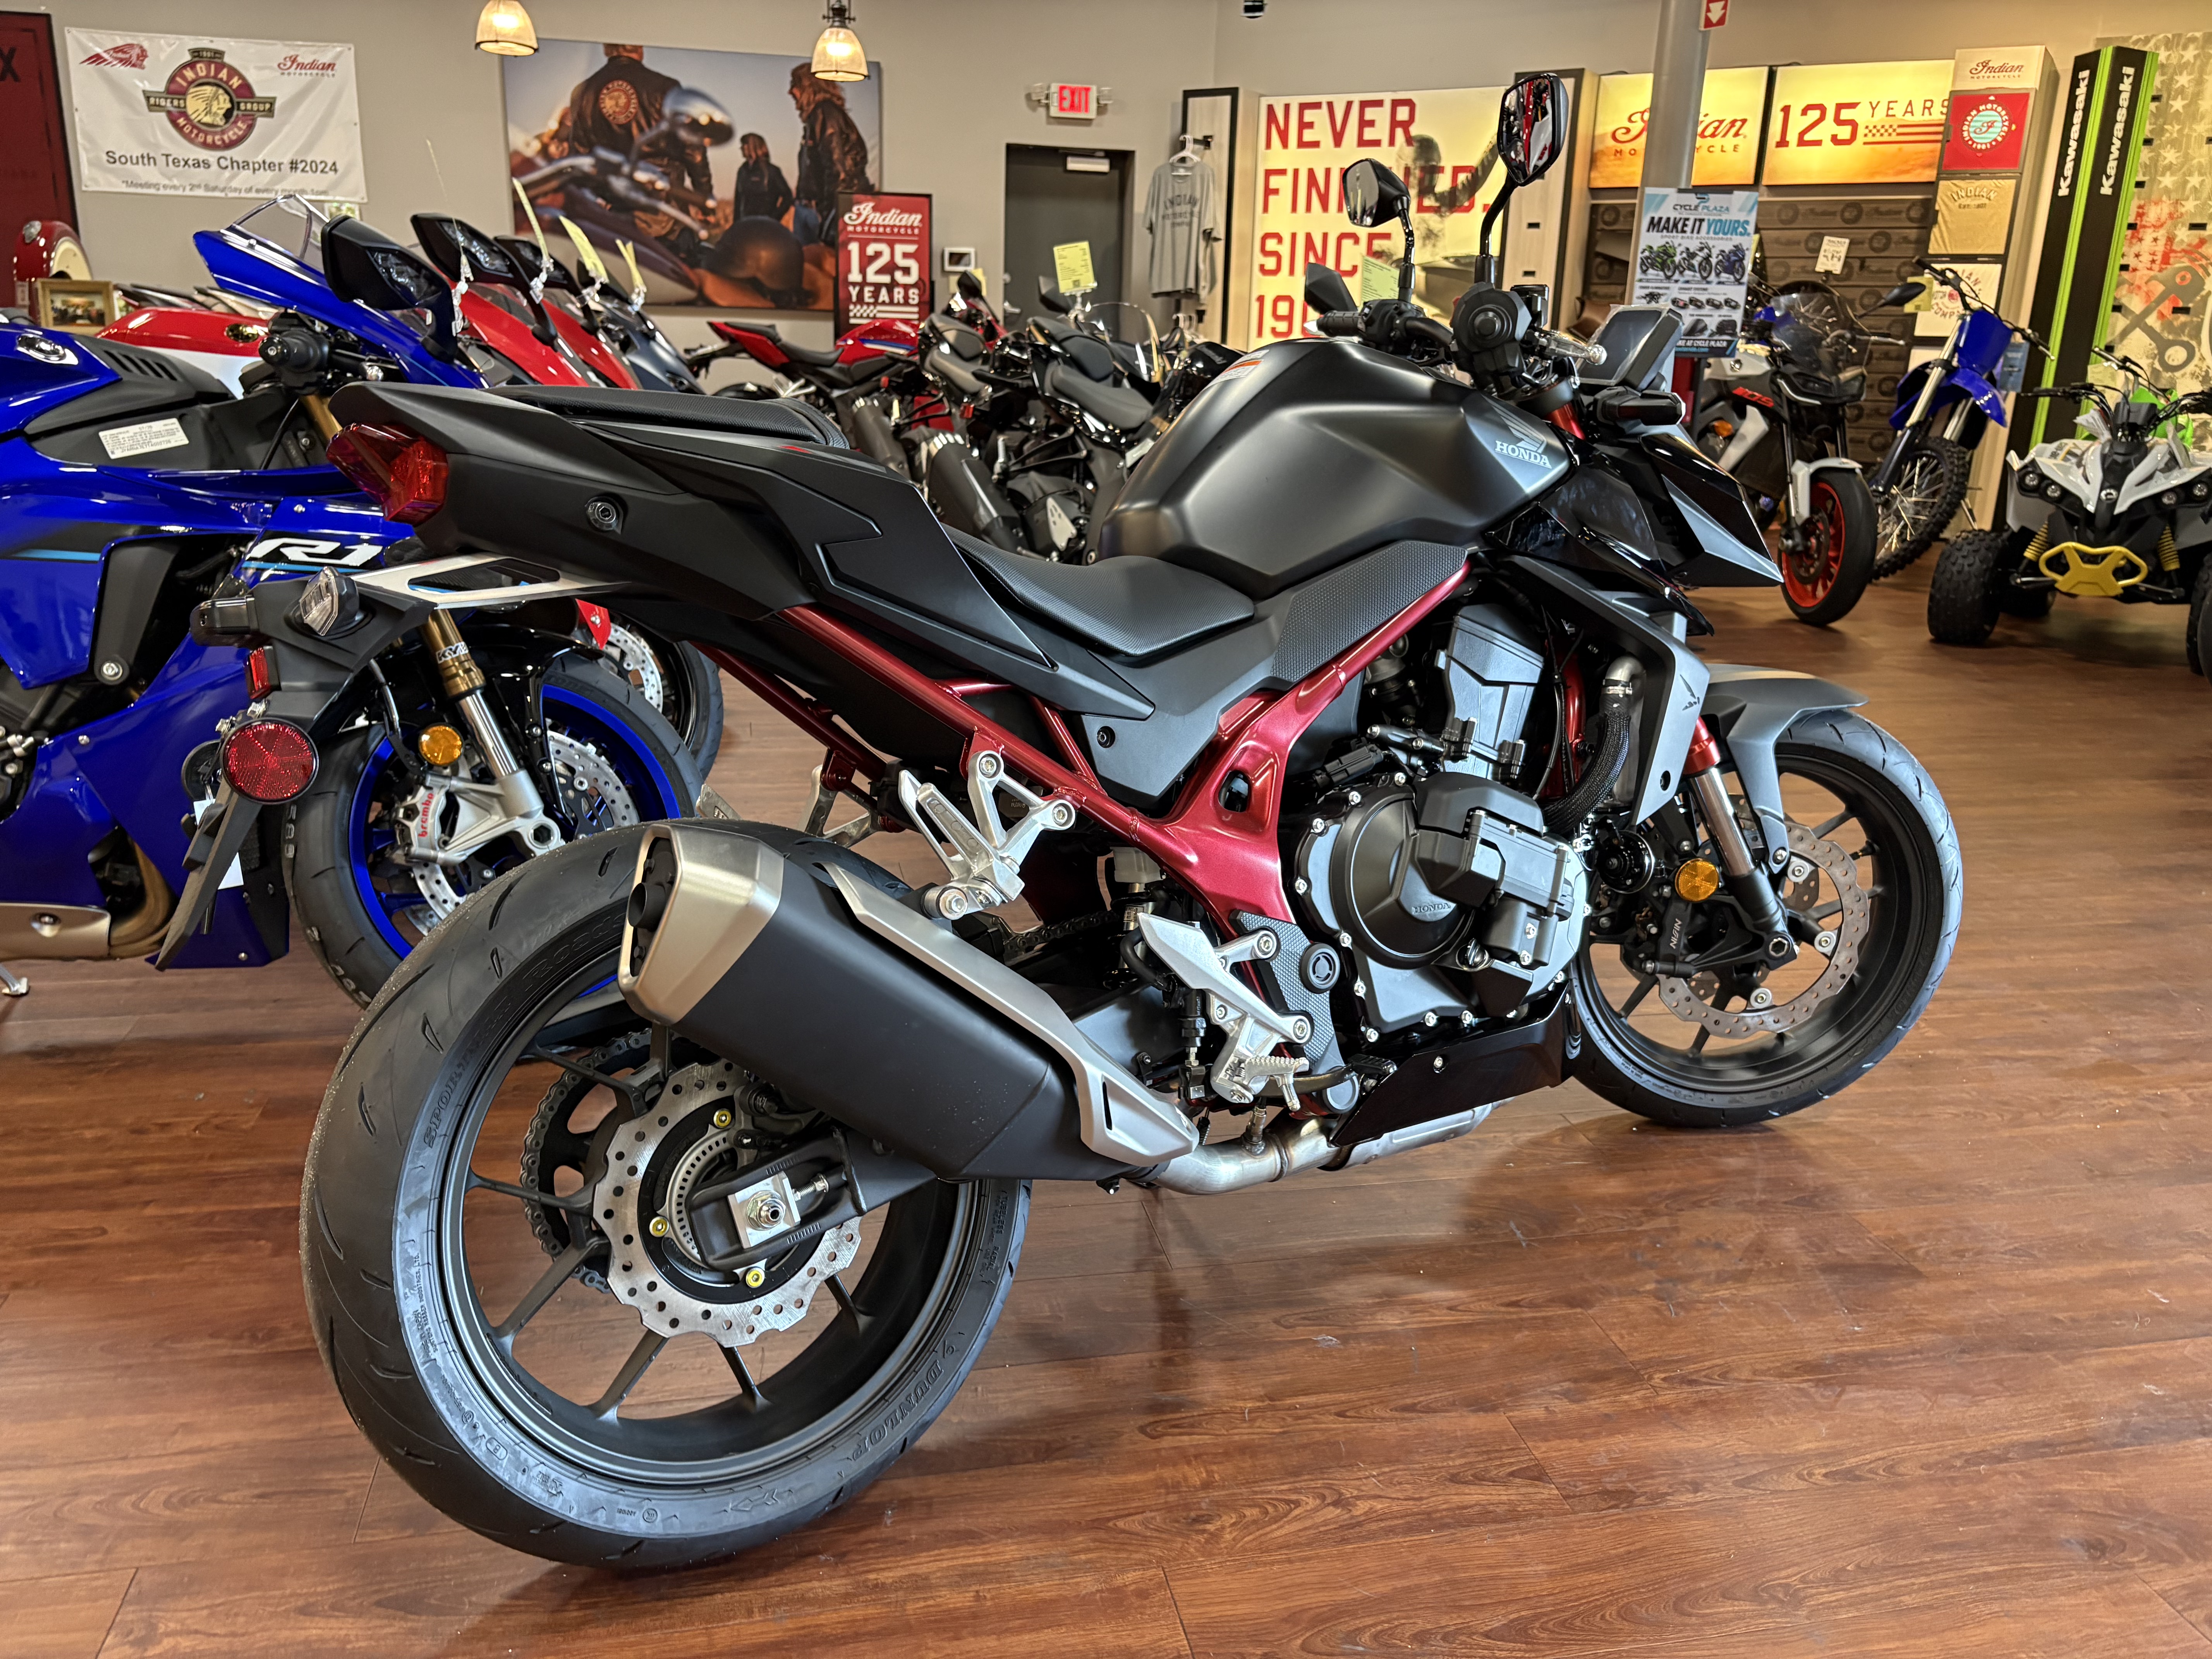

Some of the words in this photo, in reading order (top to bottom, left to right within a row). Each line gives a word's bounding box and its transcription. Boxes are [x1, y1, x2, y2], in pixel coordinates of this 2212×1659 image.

[176, 63, 243, 89] INDIAN
[277, 54, 336, 72] Indian
[1969, 60, 2024, 75] Indian
[149, 97, 185, 107] RIDERS
[240, 102, 271, 111] GROUP
[1058, 85, 1091, 114] EXIT
[177, 117, 247, 145] MOTORCYCLE
[1266, 99, 1416, 150] NEVER
[1775, 101, 1861, 148] 125
[1869, 99, 1949, 118] YEARS
[1962, 110, 1978, 141] INDIAN
[1979, 103, 2009, 142] MOTORCYCLE
[2058, 69, 2090, 197] Kawasaki
[2100, 66, 2135, 196] Kawasaki
[106, 151, 156, 167] South
[162, 154, 211, 169] Texas
[217, 156, 283, 174] Chapter
[290, 159, 338, 174] #2024
[1262, 165, 1491, 214] FINIED.
[1950, 187, 1997, 202] INDIAN
[843, 201, 922, 227] Indian
[1647, 216, 1690, 234] MAKE
[1690, 218, 1705, 234] IT
[1706, 218, 1751, 237] YOURS.
[847, 225, 919, 235] MOTORCYCLE
[847, 241, 919, 285] 125
[848, 285, 919, 304] YEARS
[1495, 440, 1551, 468] HONDA
[246, 538, 383, 566] R1
[418, 793, 434, 838] brembo
[1412, 902, 1450, 914] HONDA
[1669, 918, 1682, 949] NISSIN
[853, 1360, 944, 1461] DUNLOP
